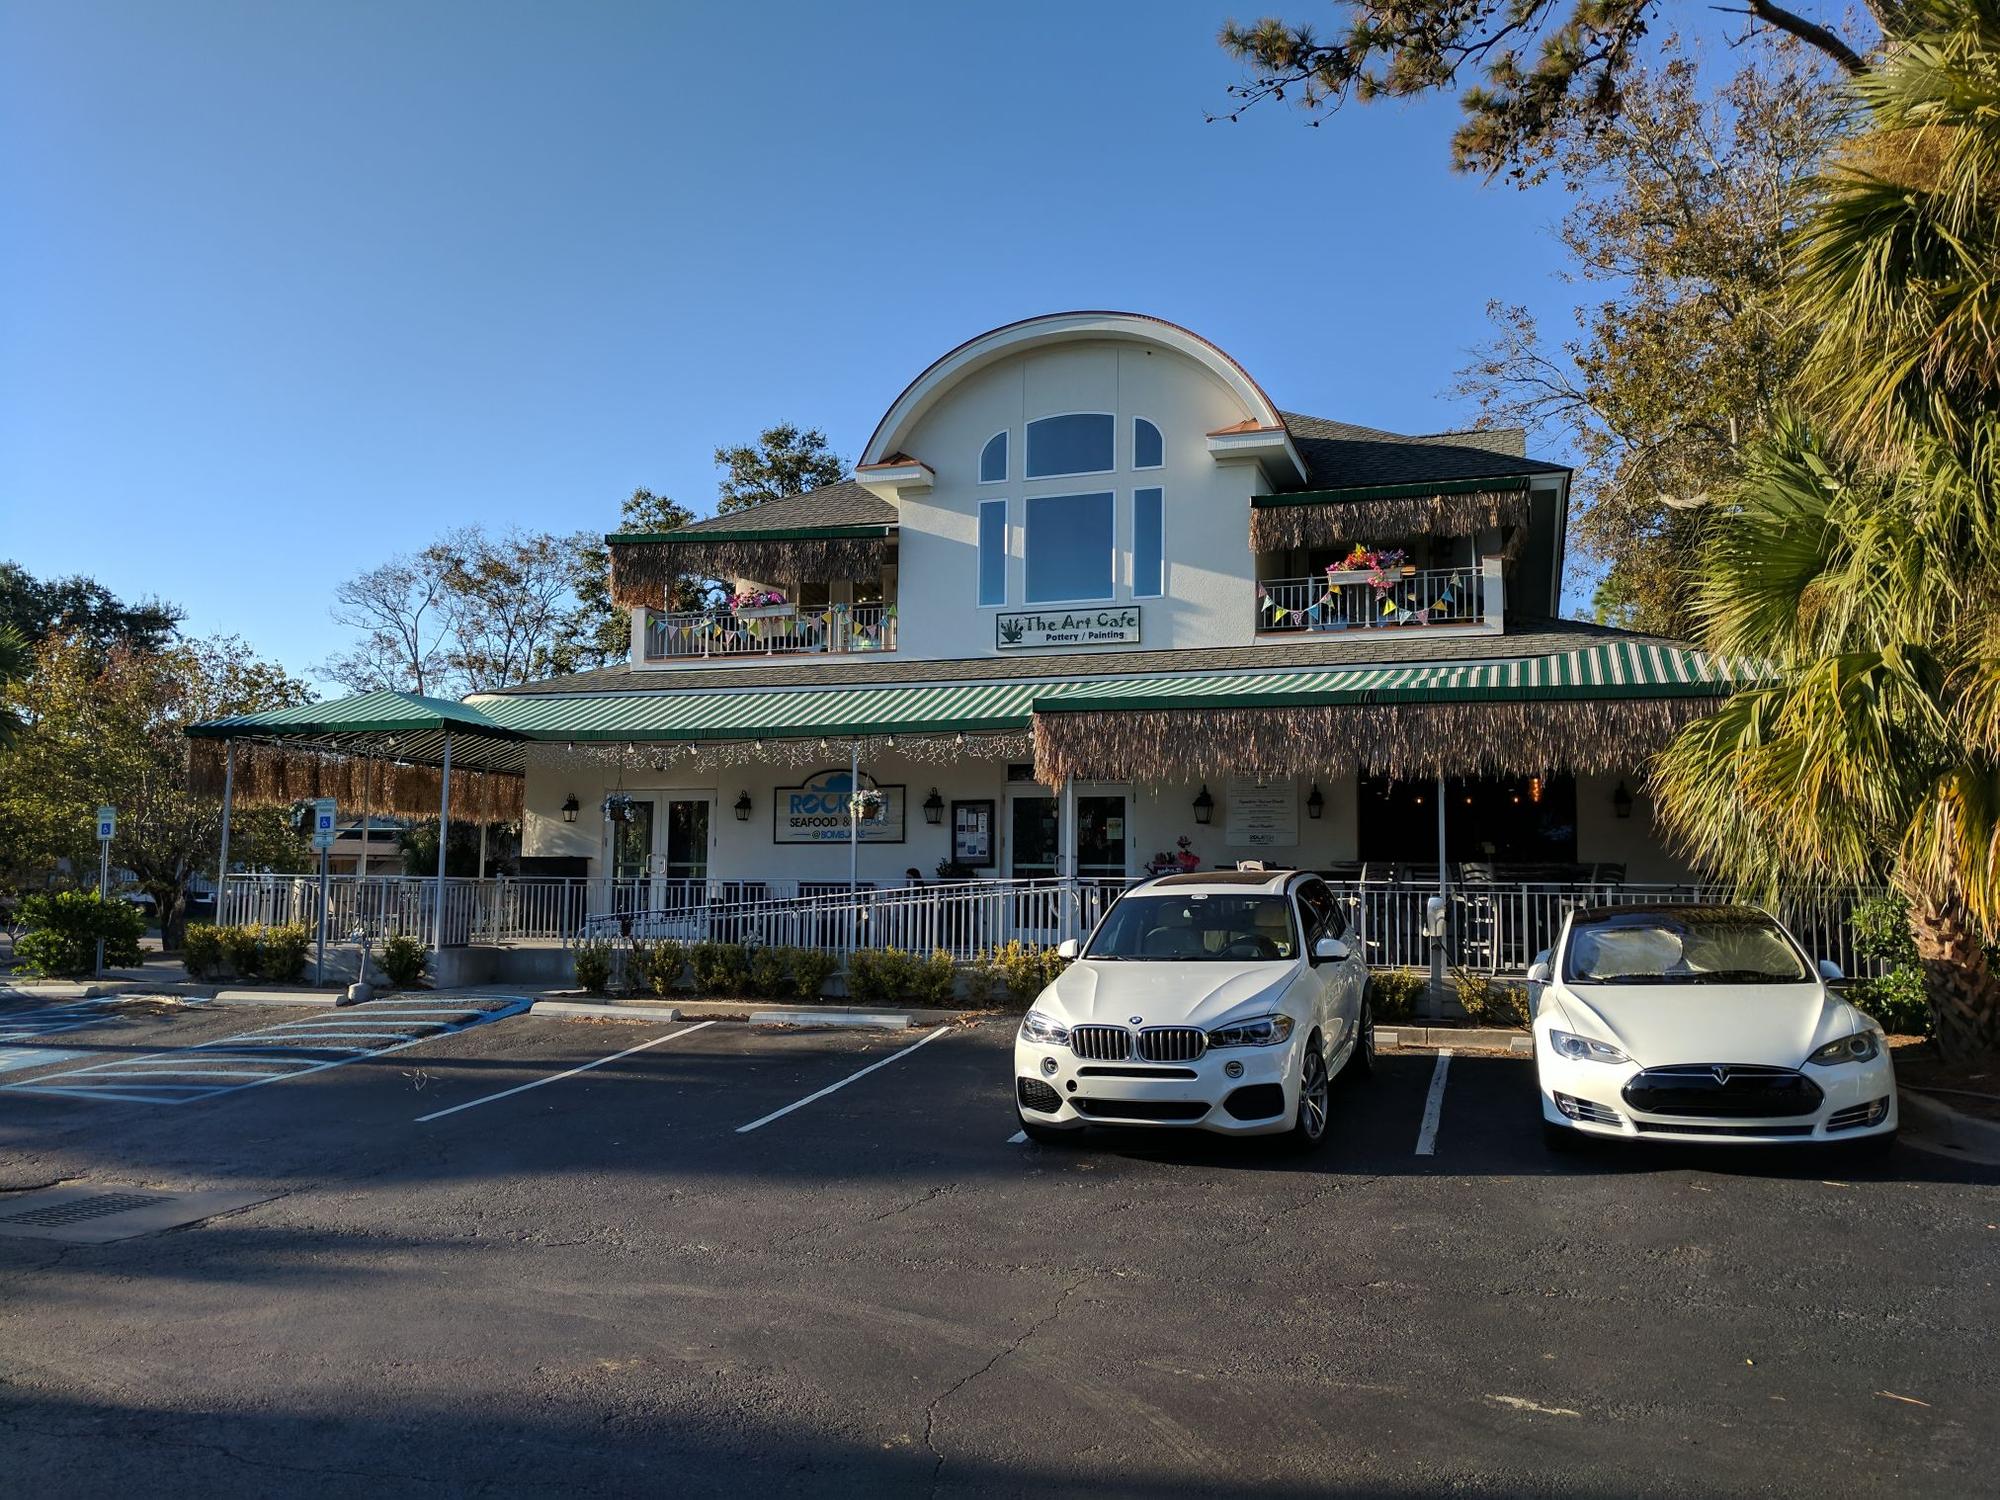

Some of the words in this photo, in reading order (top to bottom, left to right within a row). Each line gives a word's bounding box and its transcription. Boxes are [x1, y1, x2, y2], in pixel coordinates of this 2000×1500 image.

[1024, 615, 1057, 632] The
[1061, 614, 1091, 630] Art
[1097, 611, 1136, 628] Cafe
[1046, 633, 1079, 642] Pottery
[1088, 630, 1125, 641] Painting
[790, 793, 889, 815] ROCKH
[790, 817, 838, 828] SEAFOOD
[842, 817, 851, 828] &
[812, 830, 865, 840] @BOMBOAS
